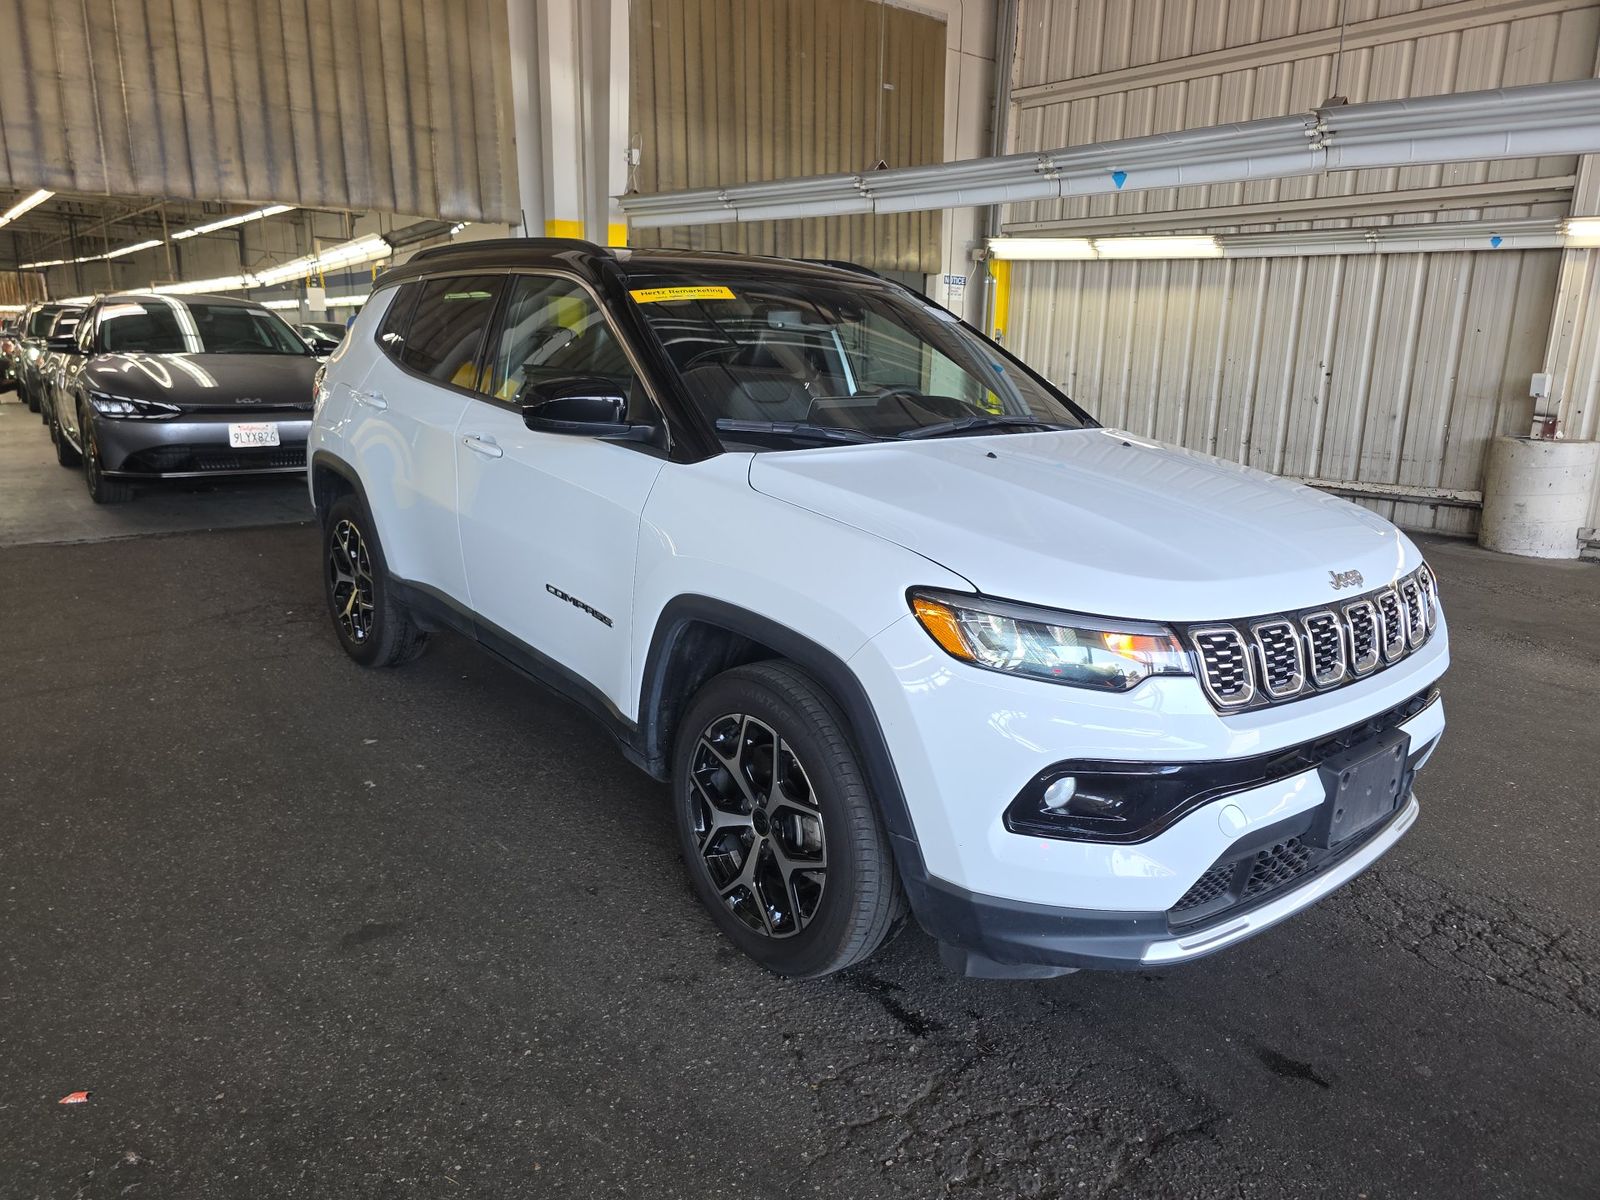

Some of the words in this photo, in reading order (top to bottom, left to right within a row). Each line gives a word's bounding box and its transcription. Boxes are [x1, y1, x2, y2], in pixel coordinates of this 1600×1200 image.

[944, 275, 966, 285] NOTICE
[668, 287, 724, 295] Remarketing
[233, 431, 276, 443] 9LYX826
[1328, 569, 1364, 590] Jeep
[545, 583, 613, 628] COMPASS
